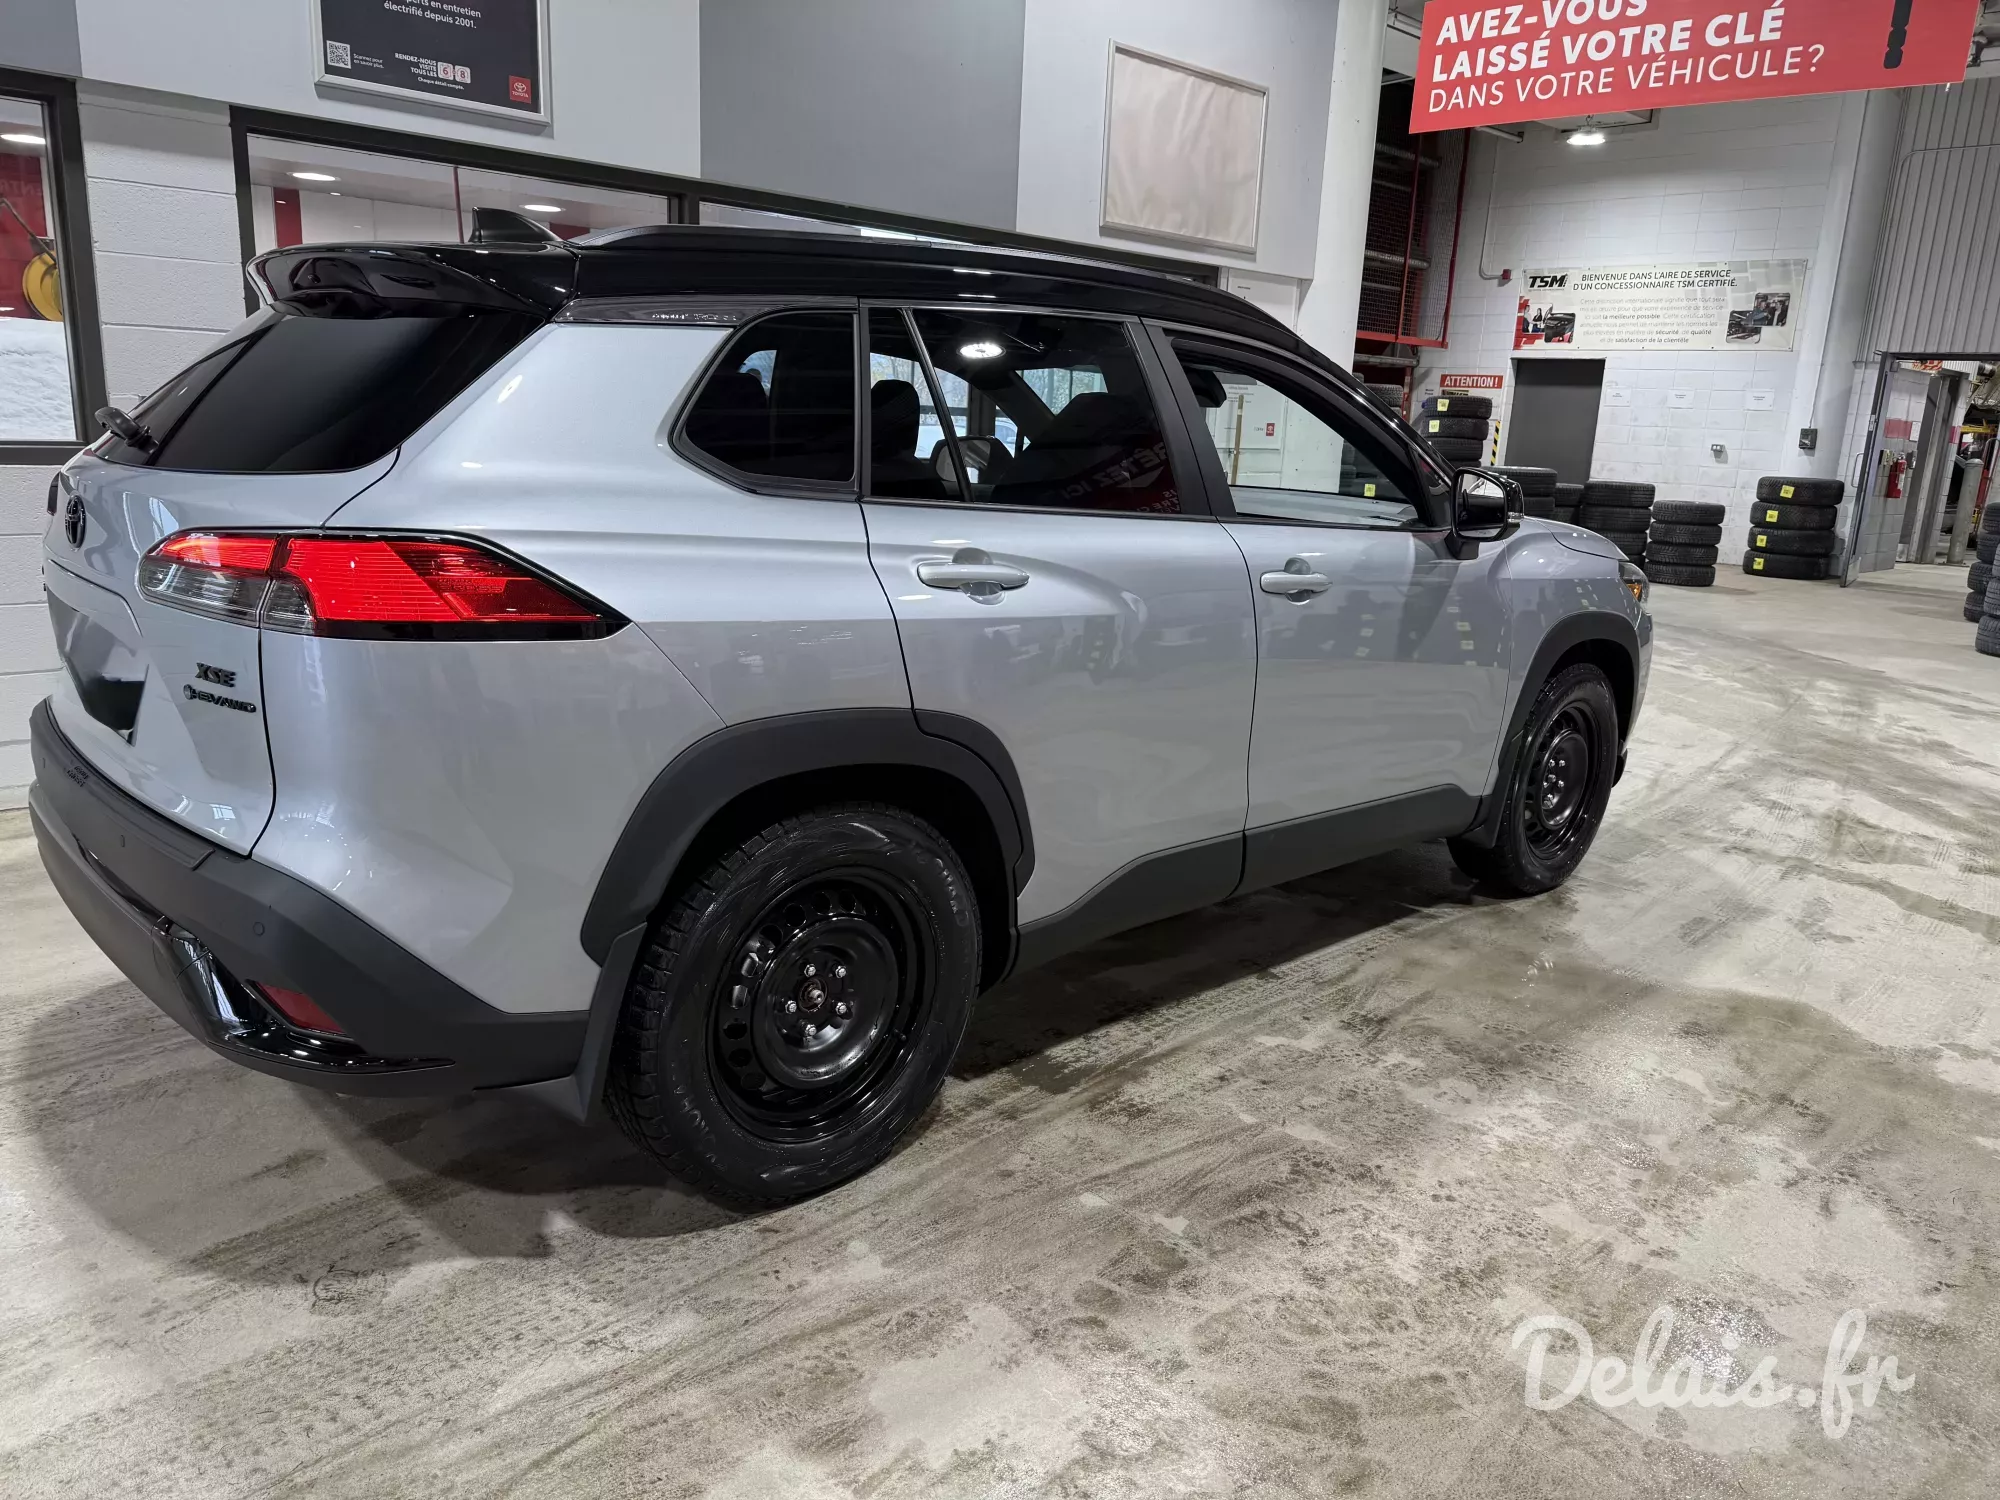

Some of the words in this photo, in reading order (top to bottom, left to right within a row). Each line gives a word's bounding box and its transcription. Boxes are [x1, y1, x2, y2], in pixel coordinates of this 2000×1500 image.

[384, 1, 423, 17] électrifié
[424, 10, 454, 24] depuis
[454, 16, 477, 28] 2001.
[430, 1, 442, 9] en
[442, 4, 482, 18] entretien
[1435, 0, 1648, 46] AVEZ-VOUS
[1432, 30, 1551, 83] LAISSÉ
[1562, 18, 1694, 65] VOTRE
[1704, 0, 1786, 47] CLÉ
[394, 52, 437, 66] RENDEZ-NOUS
[410, 66, 426, 76] TOUS
[442, 66, 448, 75] 6
[460, 70, 466, 79] 8
[1428, 81, 1505, 113] DANS
[1515, 66, 1615, 102] VOTRE
[1528, 273, 1567, 288] TSM
[1581, 272, 1628, 282] BIENVENUE
[1629, 272, 1652, 280] DANS
[1680, 270, 1692, 279] DE
[1694, 269, 1732, 278] SERVICE
[1594, 280, 1675, 290] CONCESSIONNAIRE
[1677, 280, 1694, 288] TSM
[194, 662, 236, 688] XSE
